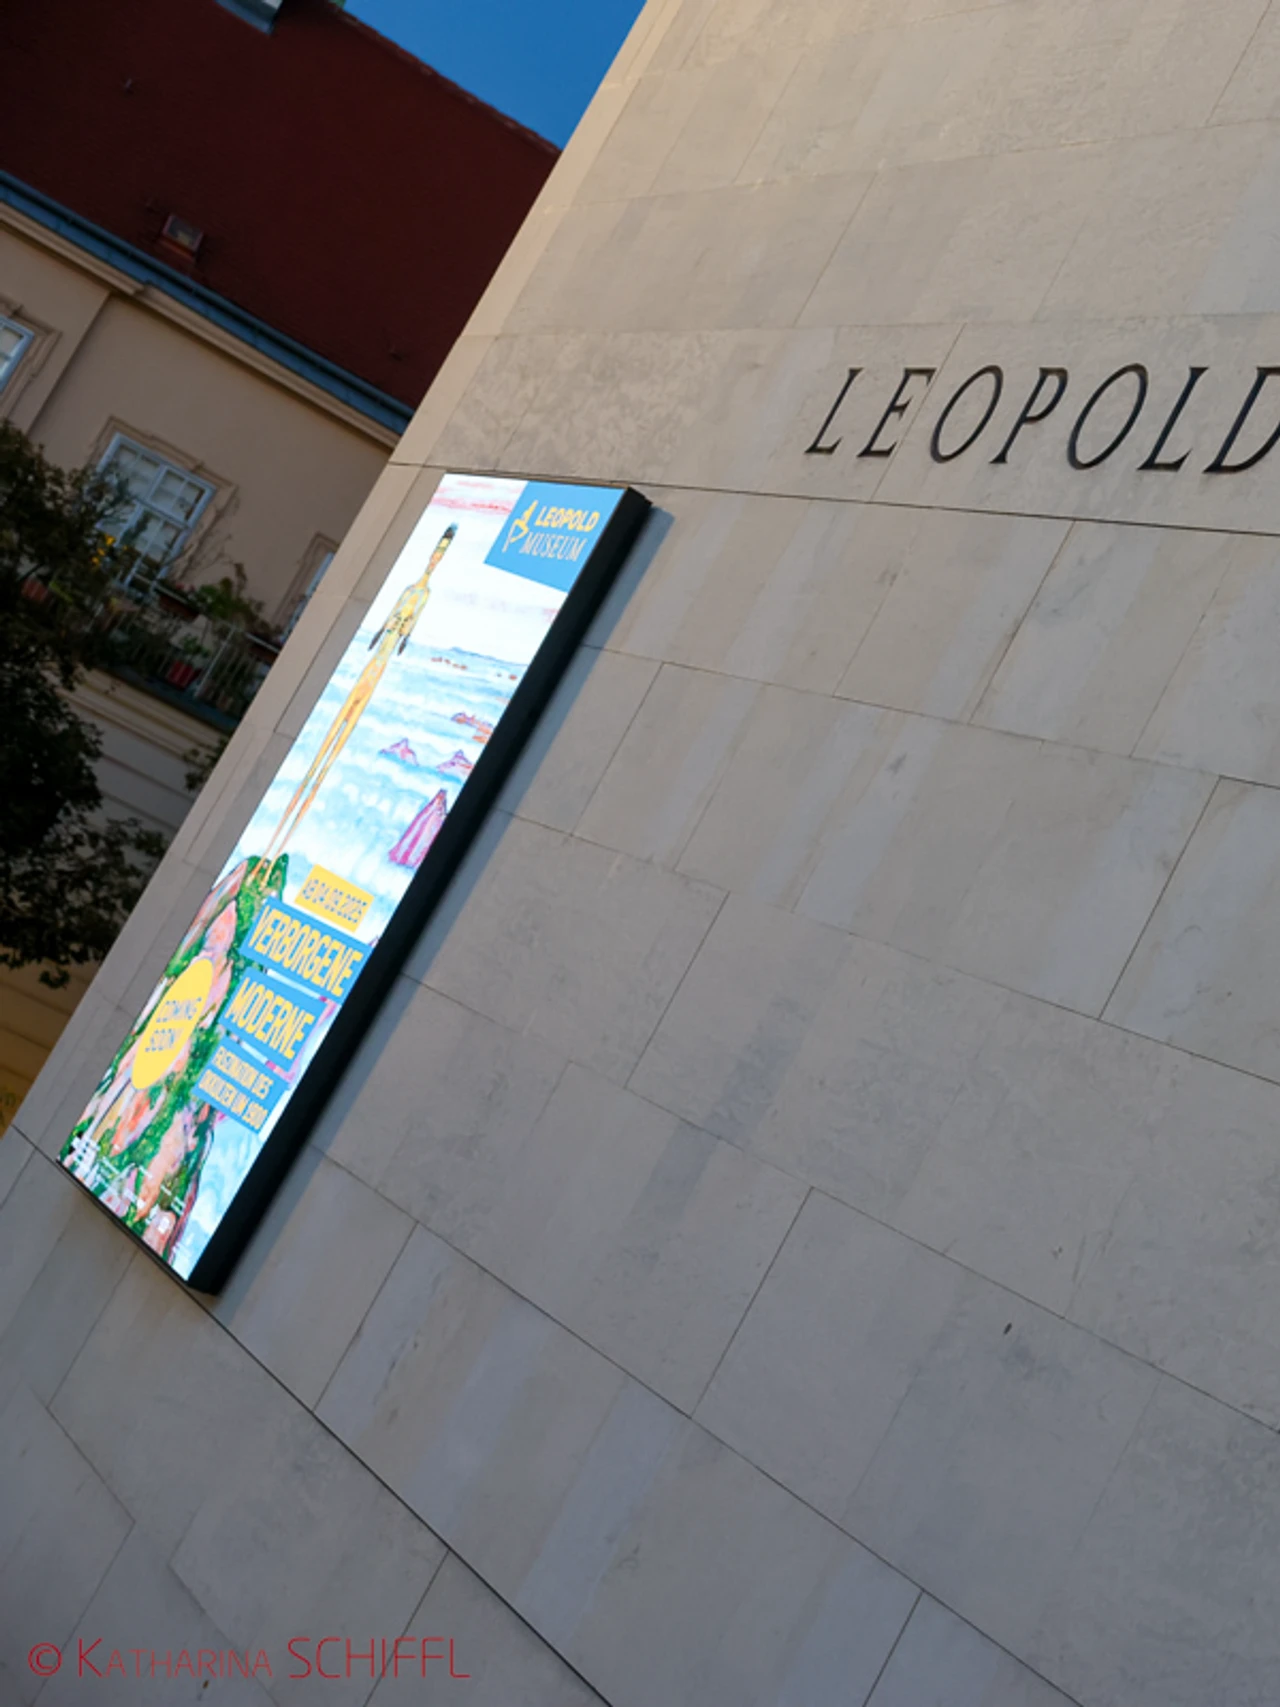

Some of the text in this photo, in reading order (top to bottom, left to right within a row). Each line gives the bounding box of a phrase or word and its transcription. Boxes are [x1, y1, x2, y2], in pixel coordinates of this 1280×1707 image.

[519, 531, 588, 562] MUSEUM
[534, 506, 601, 533] LEOPOLD
[248, 905, 363, 997] VERBORGENE
[224, 977, 315, 1060] MODERNE
